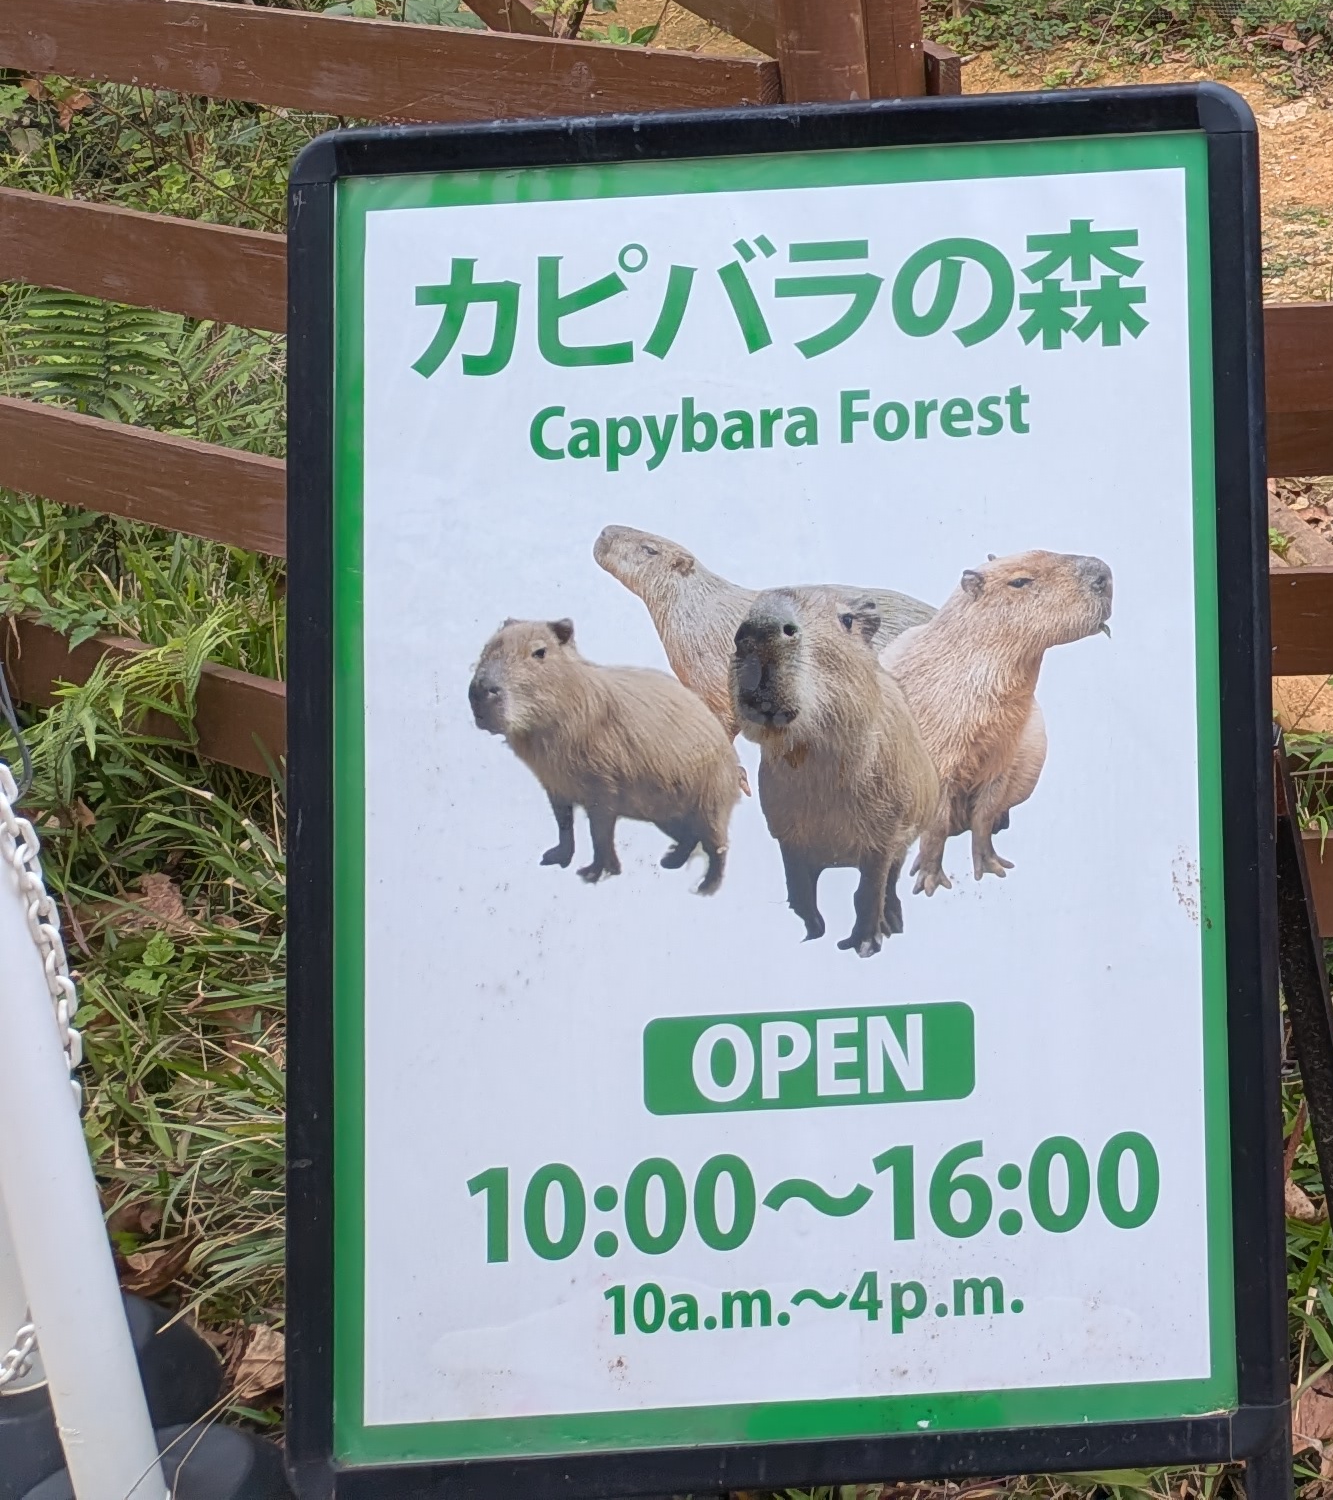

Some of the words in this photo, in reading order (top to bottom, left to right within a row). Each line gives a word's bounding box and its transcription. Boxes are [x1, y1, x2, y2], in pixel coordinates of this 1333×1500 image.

[412, 218, 1149, 378] カピバラの森
[529, 396, 819, 473] Capybara
[840, 385, 1030, 444] Forest
[691, 1012, 926, 1104] OPEN
